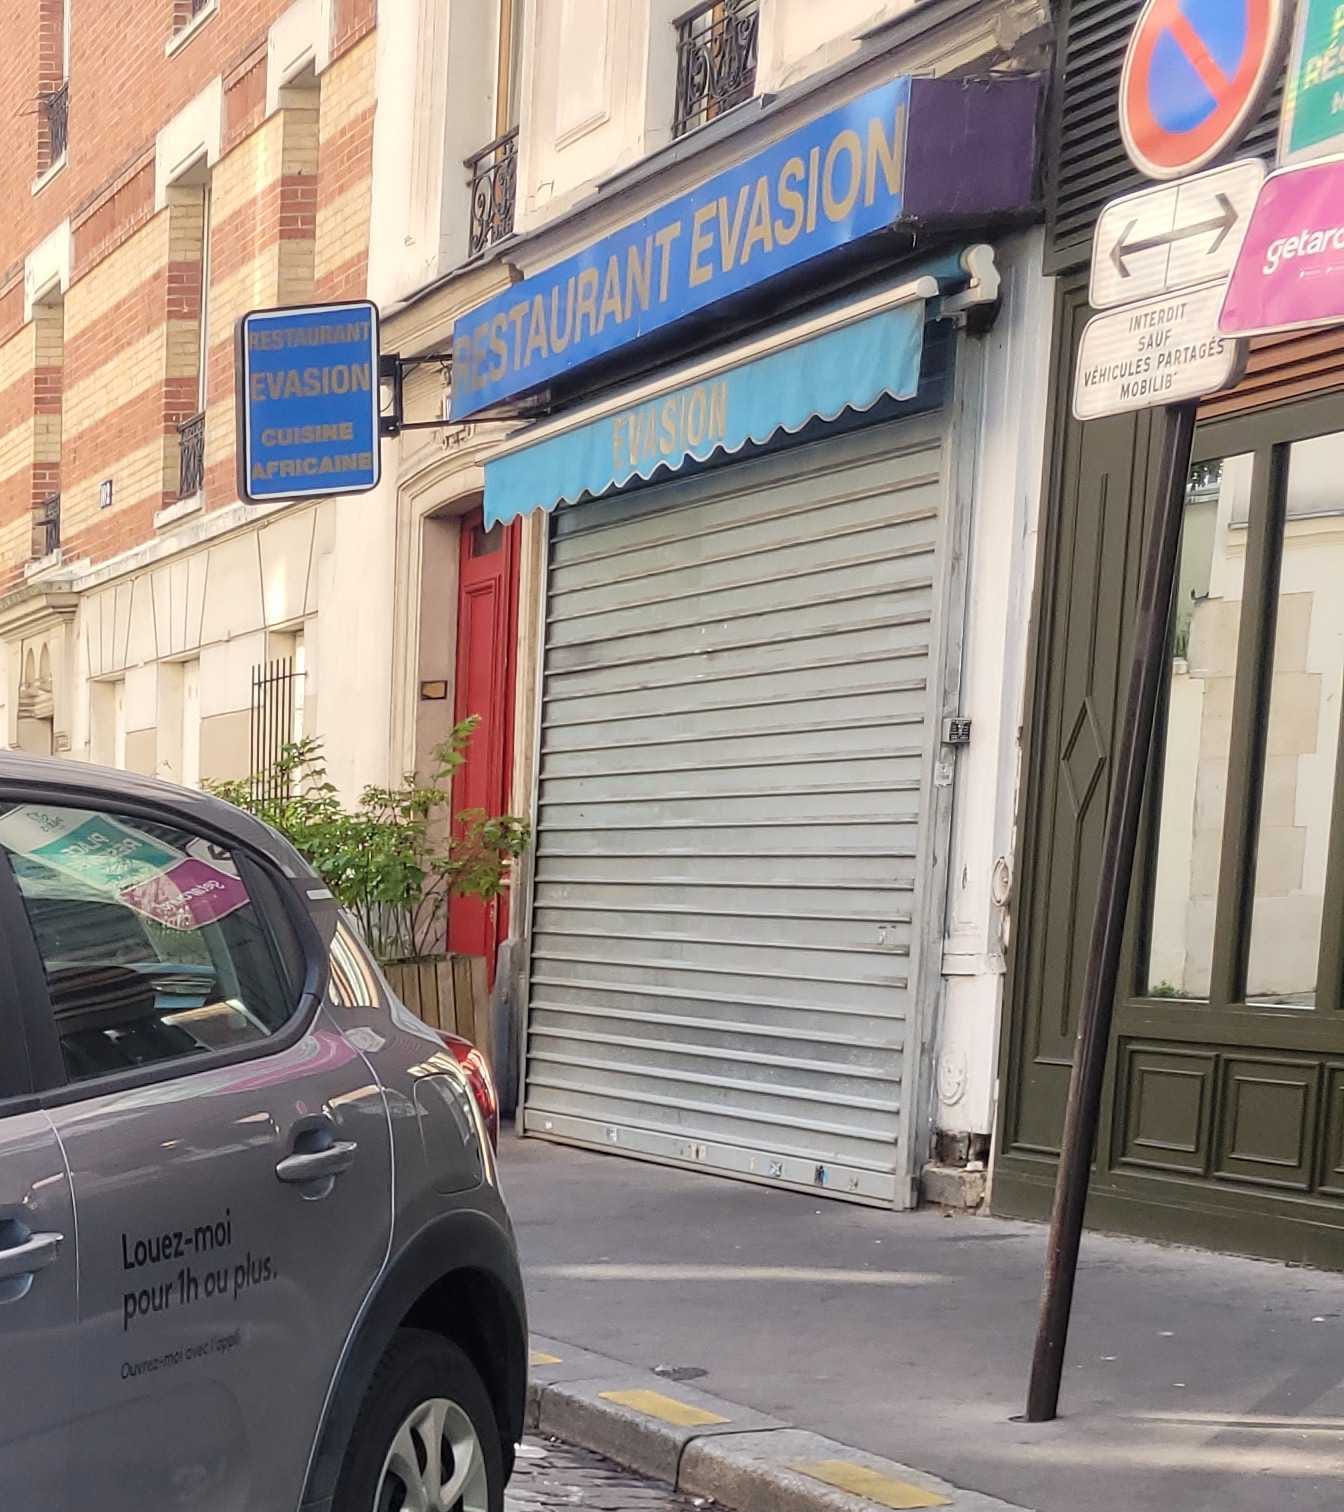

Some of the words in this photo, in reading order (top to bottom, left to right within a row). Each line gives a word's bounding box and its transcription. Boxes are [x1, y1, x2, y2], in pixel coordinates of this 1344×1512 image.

[454, 222, 682, 397] RESTAURANT
[688, 104, 907, 290] EVASION
[249, 320, 371, 351] RESTAURANT
[1128, 302, 1187, 333] INTERDIT
[1137, 328, 1172, 352] SAUF
[1083, 356, 1150, 388] VÉHICULES
[1157, 337, 1225, 370] PARTAGÉS
[251, 363, 370, 403] EVASION
[262, 421, 353, 446] CUISINE
[614, 381, 728, 469] EVASION
[251, 452, 373, 480] AFRICAINE
[122, 1207, 232, 1270] Louez-moi
[123, 1283, 173, 1331] pour
[177, 1267, 199, 1304] 1h
[204, 1269, 229, 1298] ou
[234, 1251, 277, 1302] plus.
